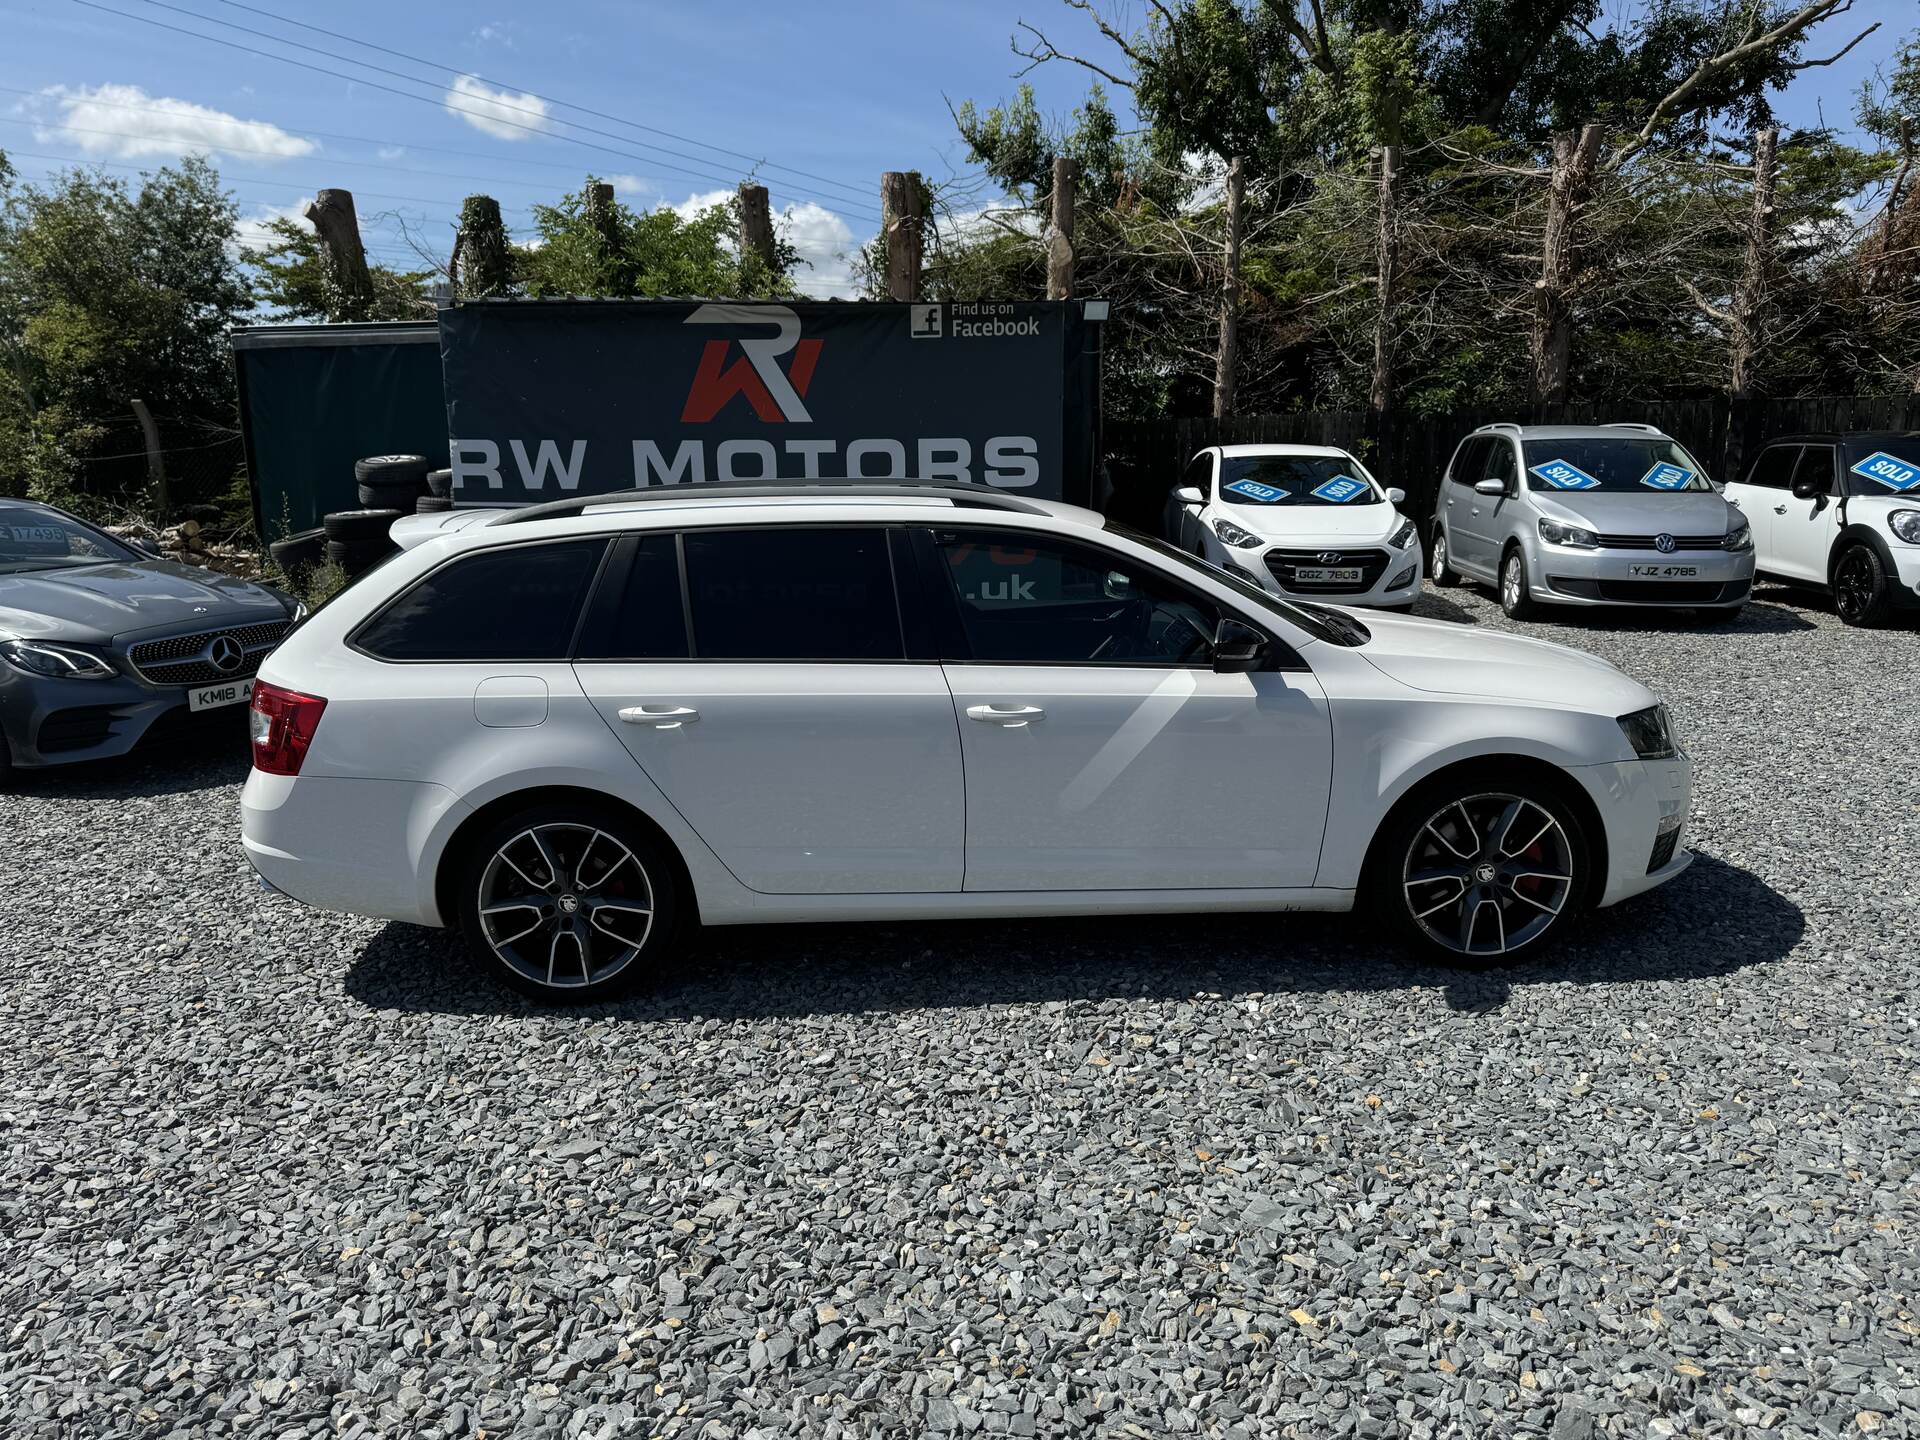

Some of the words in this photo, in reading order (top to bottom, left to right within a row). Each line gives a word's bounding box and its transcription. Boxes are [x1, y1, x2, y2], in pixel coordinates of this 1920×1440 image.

[952, 303, 978, 316] Find
[982, 304, 996, 315] us
[999, 304, 1014, 315] on
[952, 316, 1040, 337] Facebook
[449, 438, 588, 490] RW
[632, 436, 1040, 488] MOTORS
[1869, 460, 1914, 482] SOLD
[1546, 466, 1583, 487] SOLD
[1240, 483, 1275, 498] SOLD
[1326, 481, 1356, 498] SOLD
[14, 527, 64, 541] 17495
[1298, 570, 1323, 580] GGZ
[1327, 570, 1359, 580] 7803
[1632, 566, 1659, 576] YJZ
[1663, 566, 1697, 576] 4785
[198, 687, 236, 705] KM18
